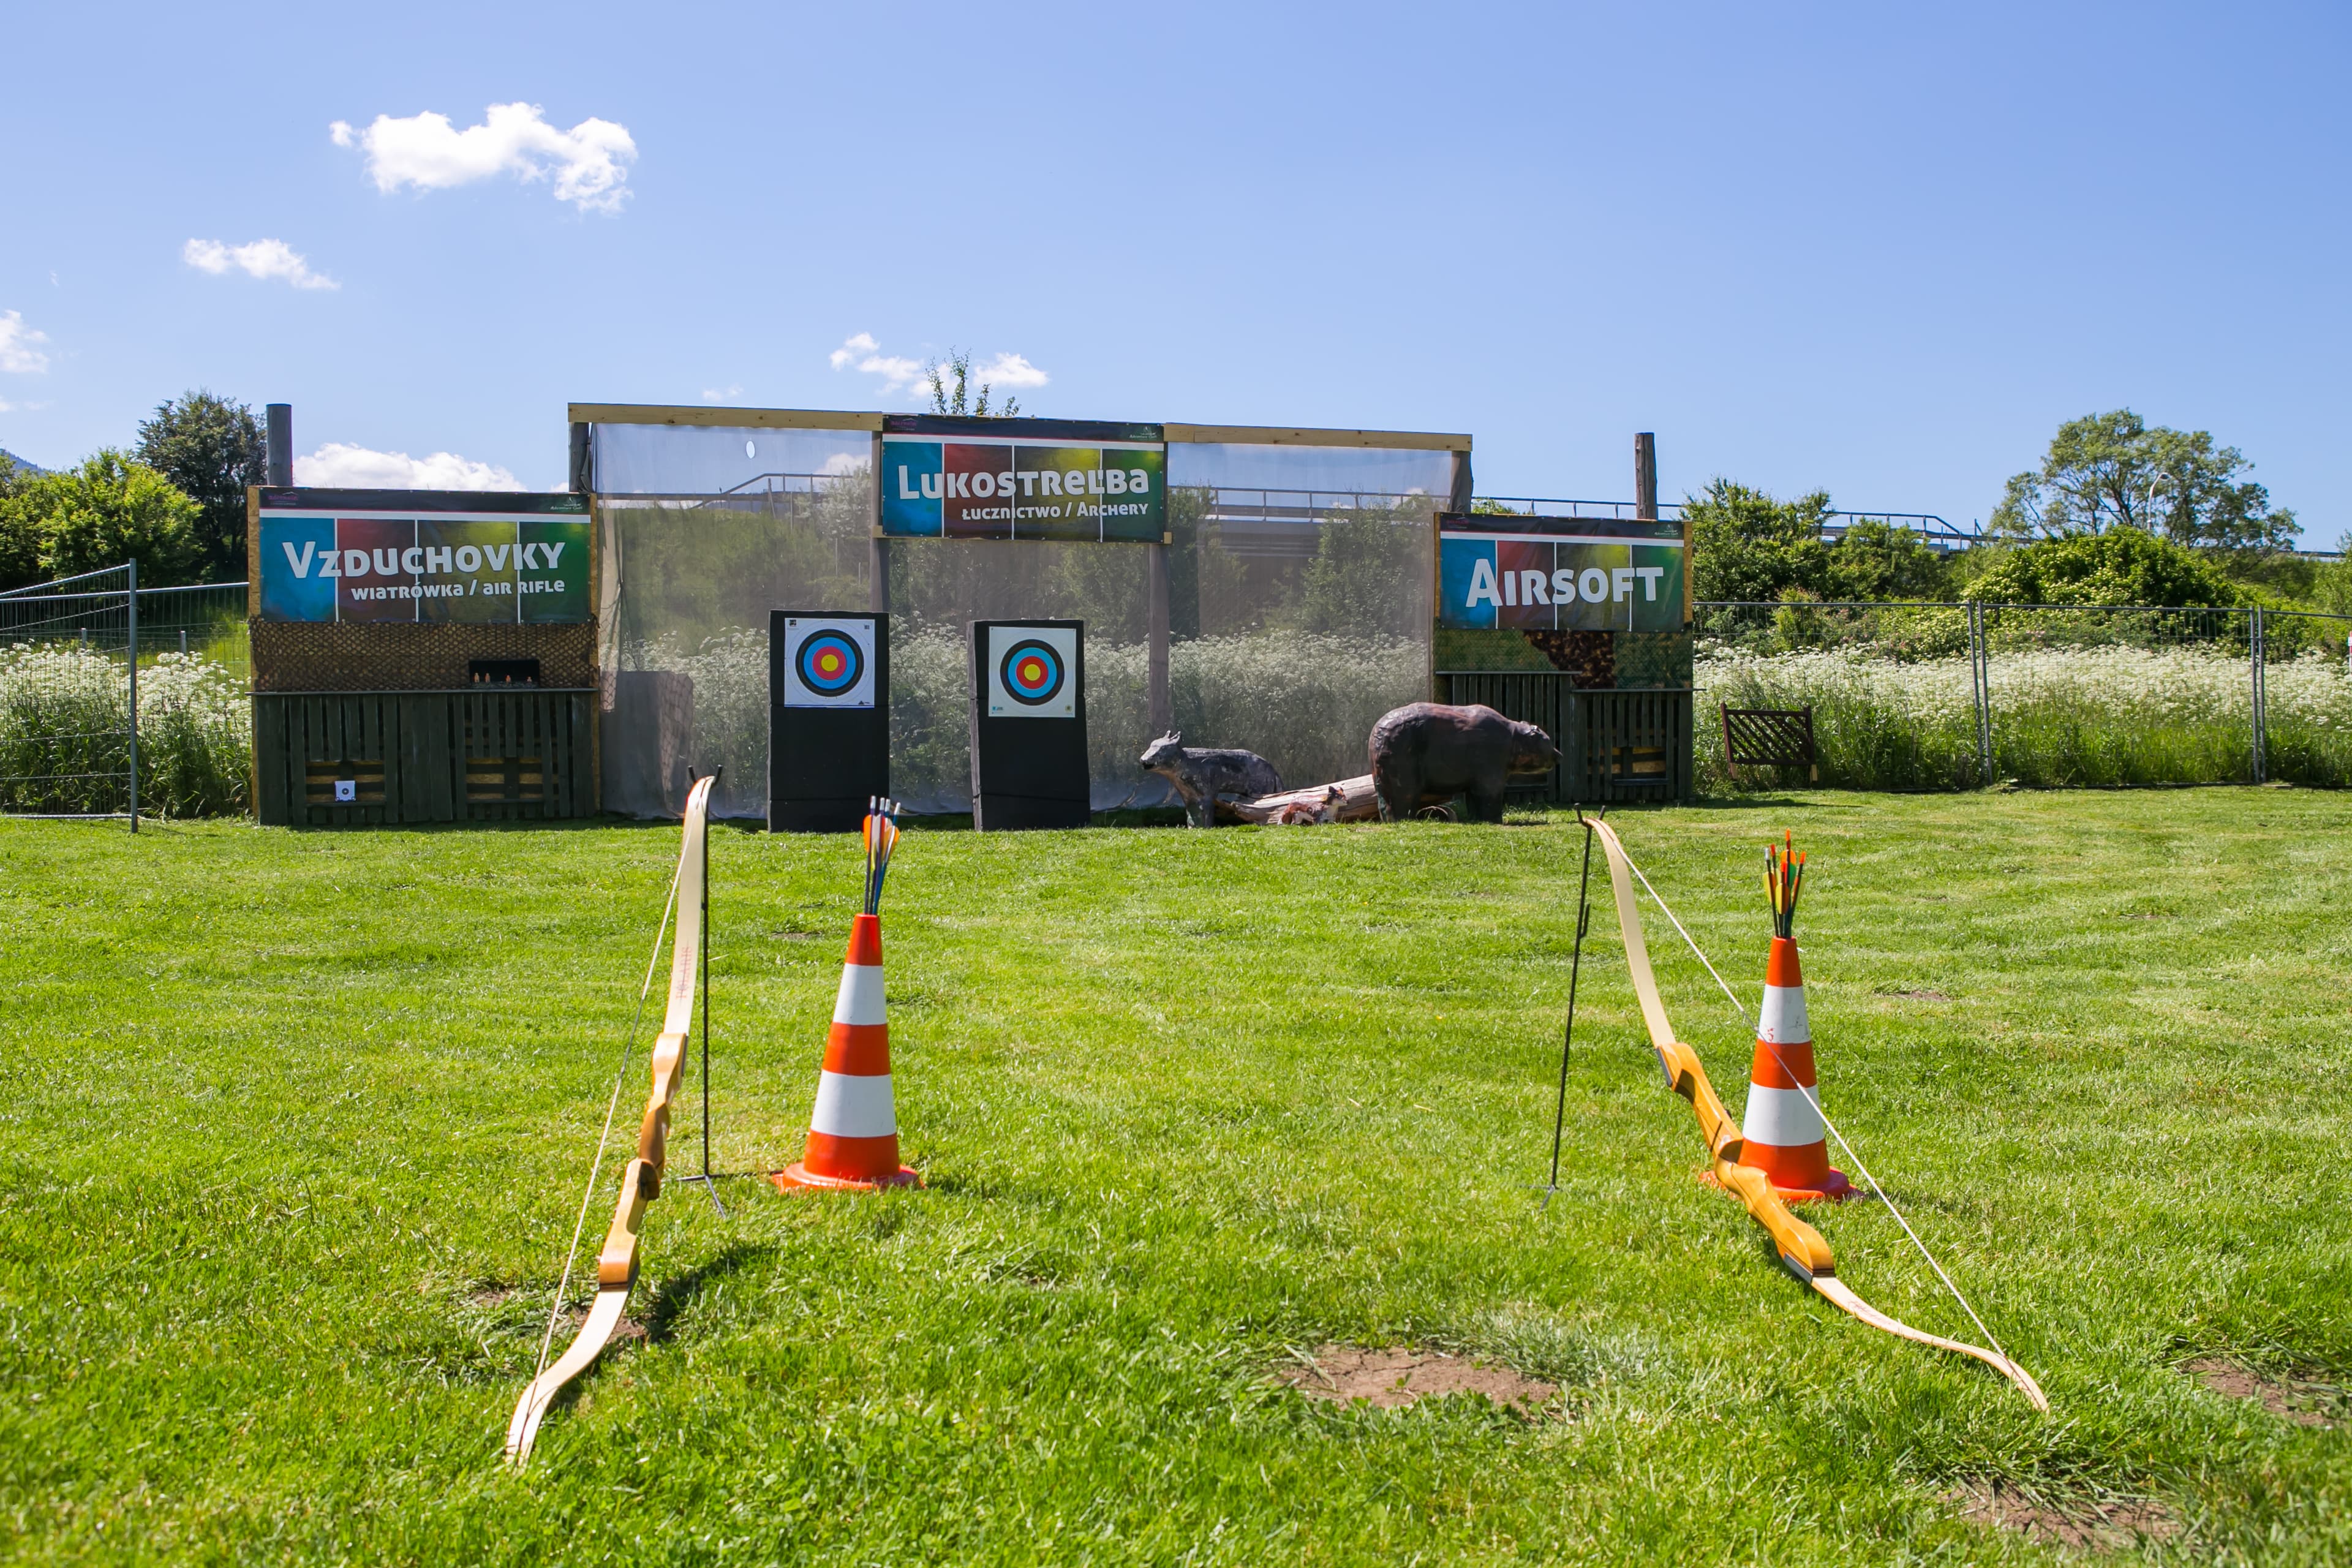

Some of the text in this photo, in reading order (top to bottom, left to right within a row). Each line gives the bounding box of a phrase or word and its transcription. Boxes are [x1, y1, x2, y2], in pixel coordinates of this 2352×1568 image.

[1065, 502, 1072, 517] /
[469, 579, 478, 596] /
[1465, 559, 1664, 608] AIRSOFT
